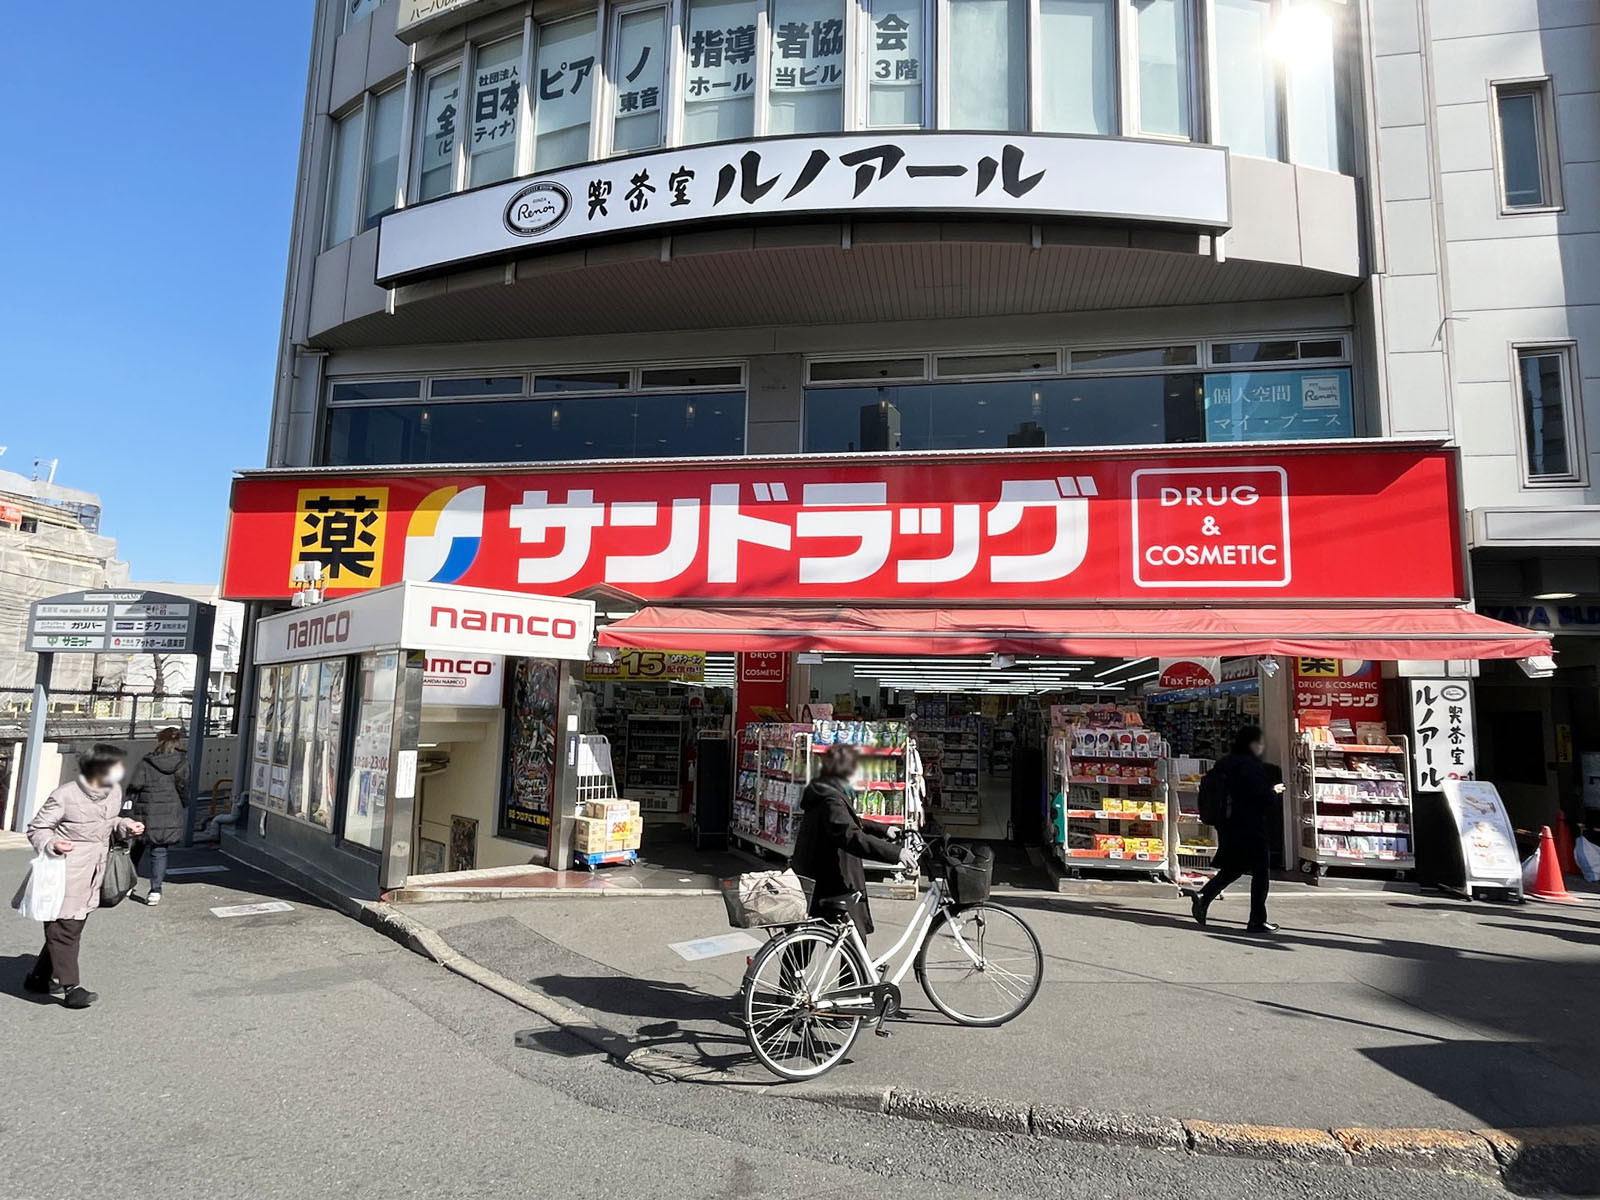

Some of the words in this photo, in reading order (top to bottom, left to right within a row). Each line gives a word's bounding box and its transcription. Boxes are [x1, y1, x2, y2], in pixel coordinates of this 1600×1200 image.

[689, 72, 754, 96] ホール
[775, 65, 842, 87] 当ビル
[588, 165, 696, 221] 喫茶室
[713, 144, 1046, 207] ルノアール
[1213, 385, 1291, 404] 個人空間
[1160, 485, 1260, 507] DRUG
[299, 496, 380, 579] 薬
[509, 476, 1099, 584] サンドラッグ
[1200, 516, 1220, 535] &
[1145, 543, 1277, 567] COSMETIC
[286, 609, 350, 651] namco
[430, 605, 577, 640] namco
[745, 668, 781, 676] COSMETIC
[1163, 675, 1184, 685] Tax
[1185, 675, 1211, 686] Free
[1333, 682, 1377, 690] COSMETIC
[1298, 693, 1379, 707] サンドラッグ
[1416, 685, 1445, 788] ルノアール
[1447, 705, 1466, 766] 喫茶室
